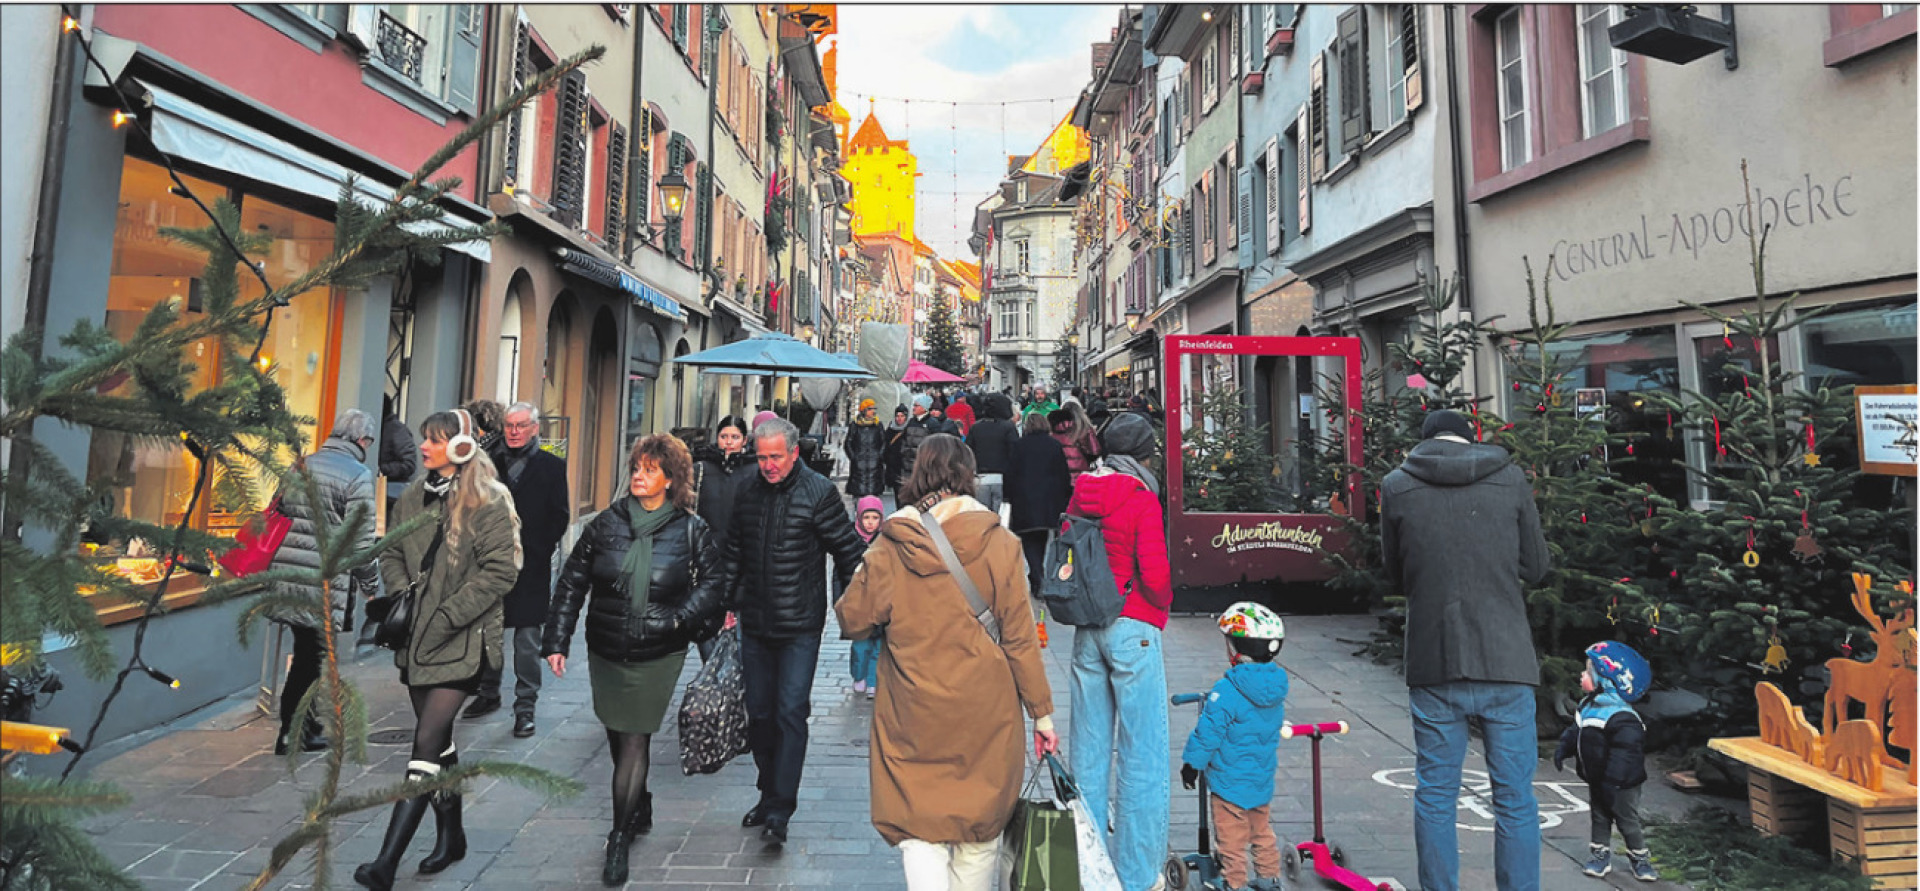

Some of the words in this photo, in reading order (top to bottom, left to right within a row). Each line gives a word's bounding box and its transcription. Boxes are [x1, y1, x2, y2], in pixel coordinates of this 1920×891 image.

[1179, 339, 1233, 350] Rheinfelden
[1211, 521, 1322, 548] Adventsfunkeln
[1266, 542, 1313, 554] RHEINFELDEN
